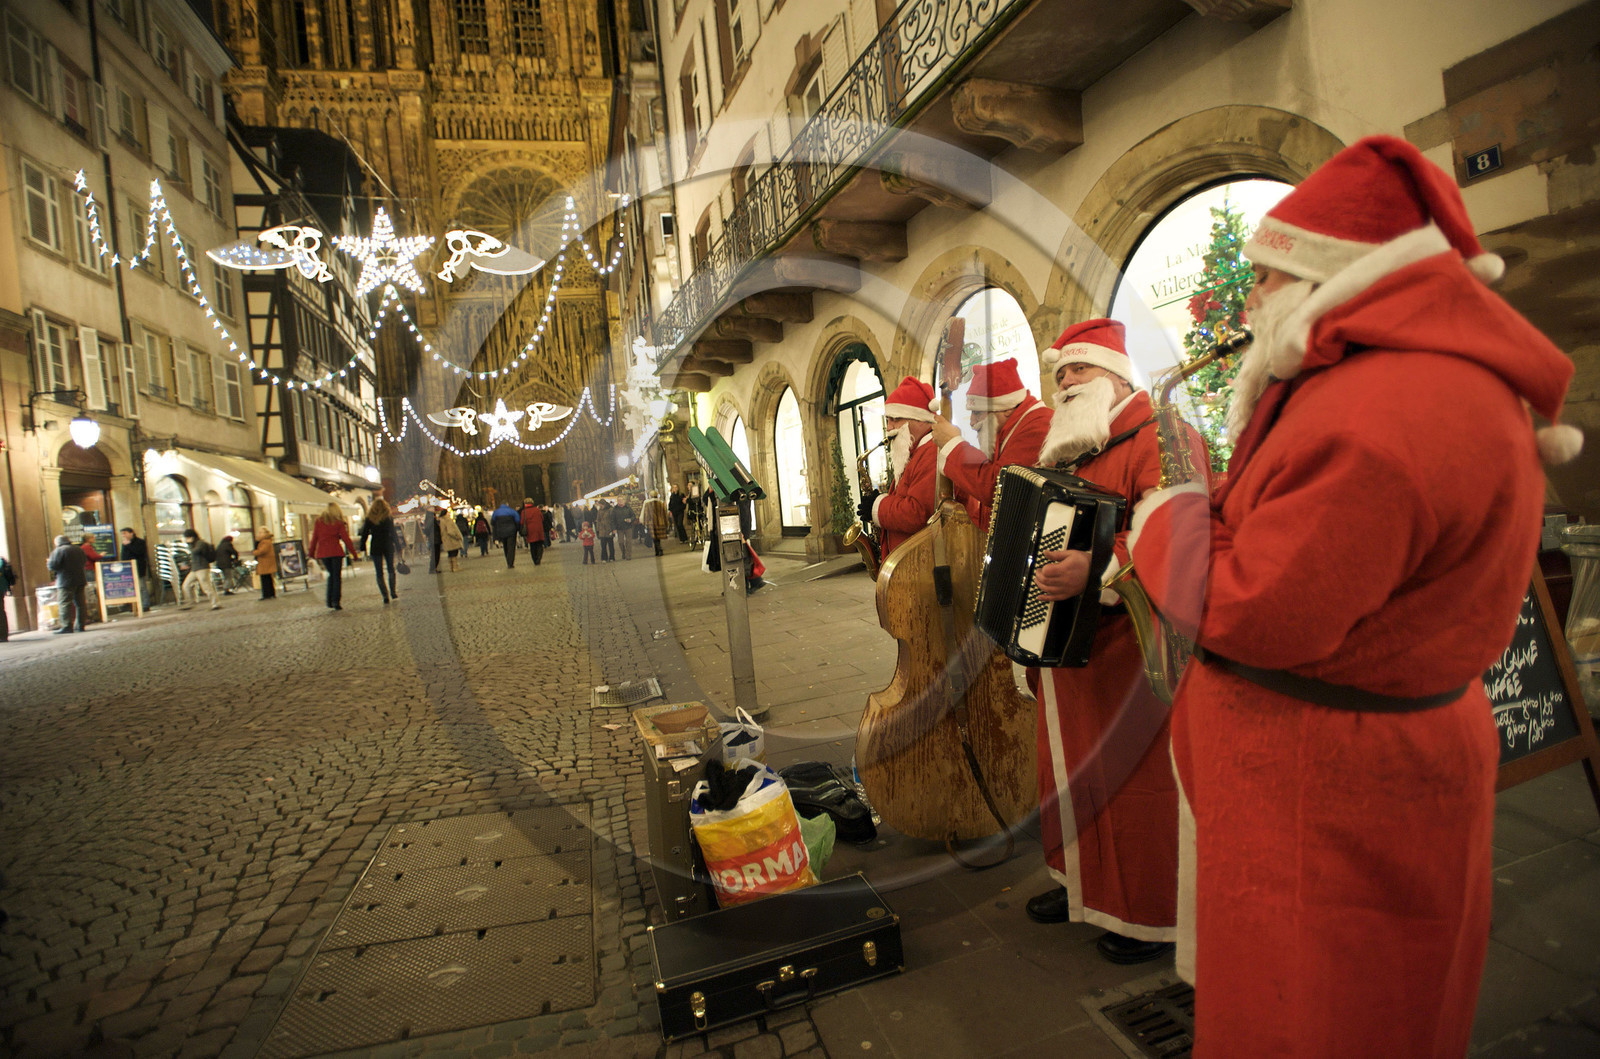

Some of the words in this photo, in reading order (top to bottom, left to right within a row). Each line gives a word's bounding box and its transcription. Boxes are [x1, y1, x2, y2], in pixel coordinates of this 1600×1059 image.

[1477, 153, 1490, 170] 8
[1166, 254, 1182, 270] La
[1150, 269, 1211, 299] Villeroy
[709, 841, 804, 894] NORMA
